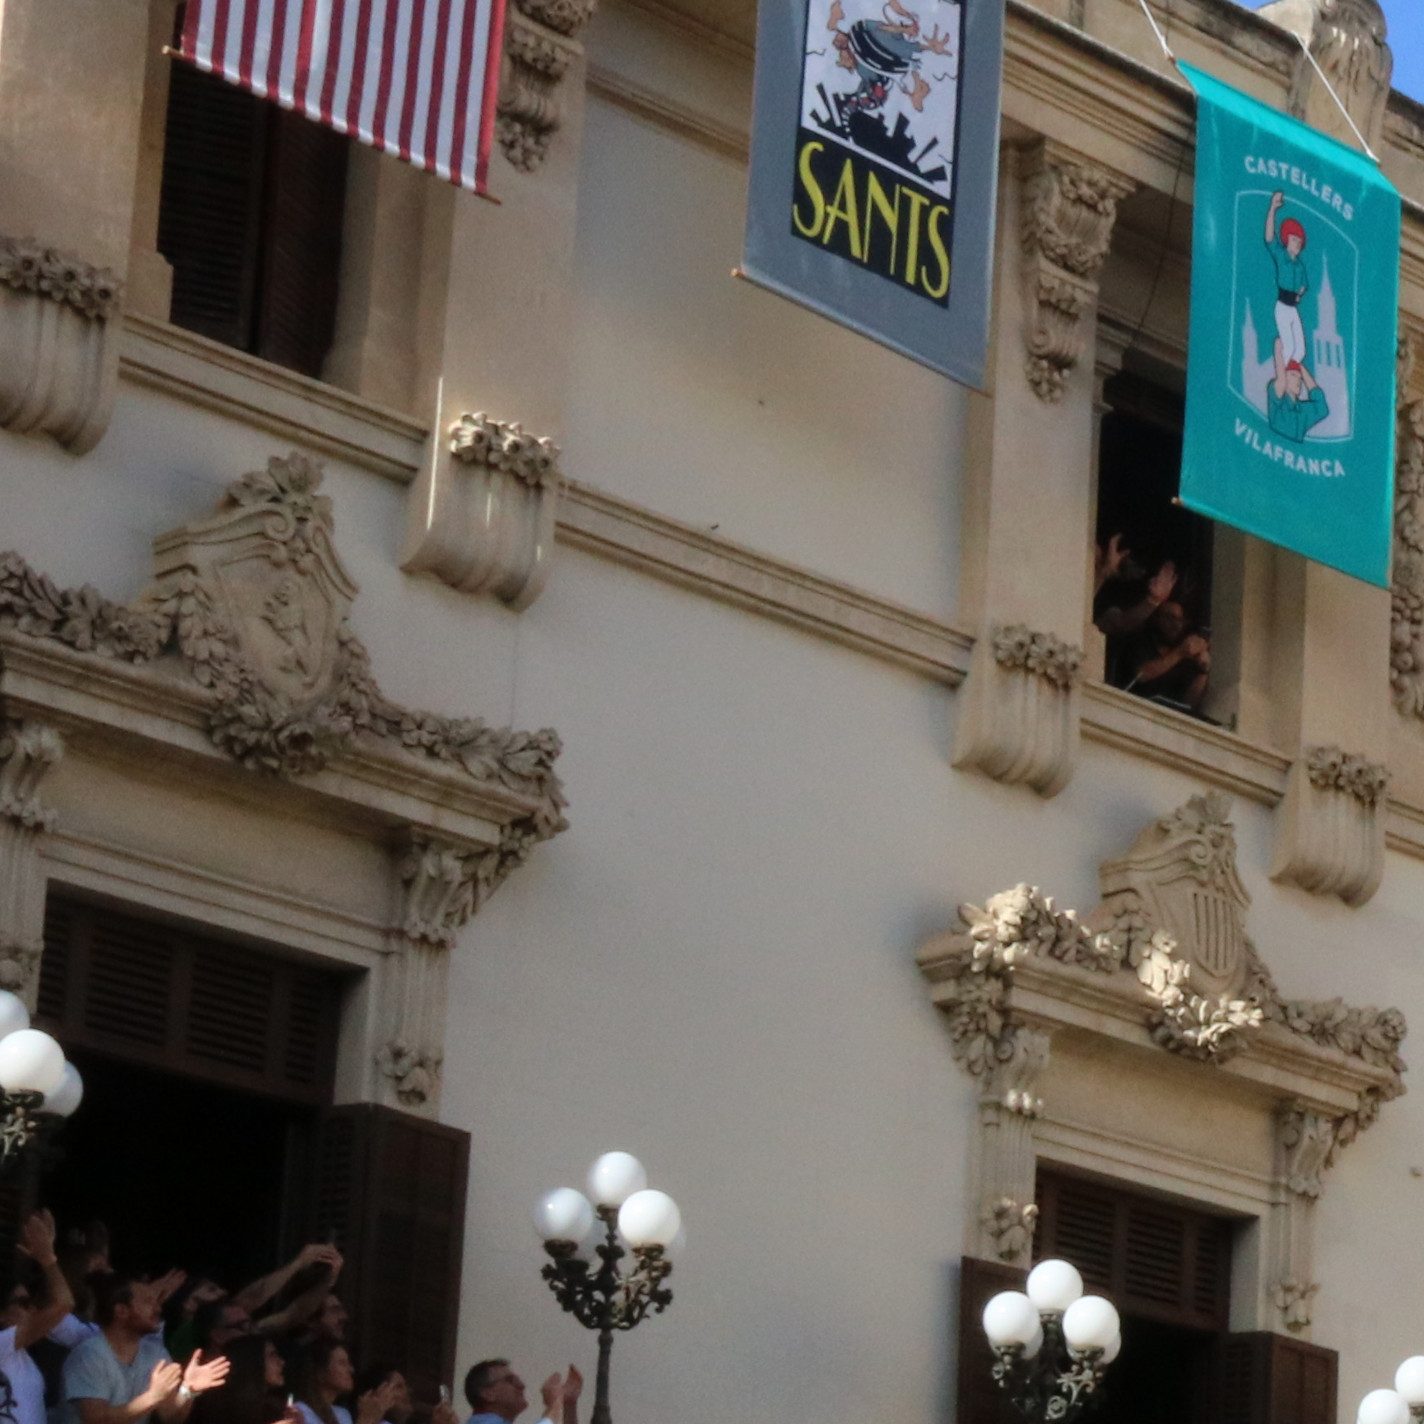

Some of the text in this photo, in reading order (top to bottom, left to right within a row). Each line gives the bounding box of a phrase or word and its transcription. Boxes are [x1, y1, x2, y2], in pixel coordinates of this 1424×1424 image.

[793, 141, 949, 298] SANTS
[1244, 155, 1354, 221] CASTELLERS
[1234, 417, 1346, 477] VILAFRANCA
